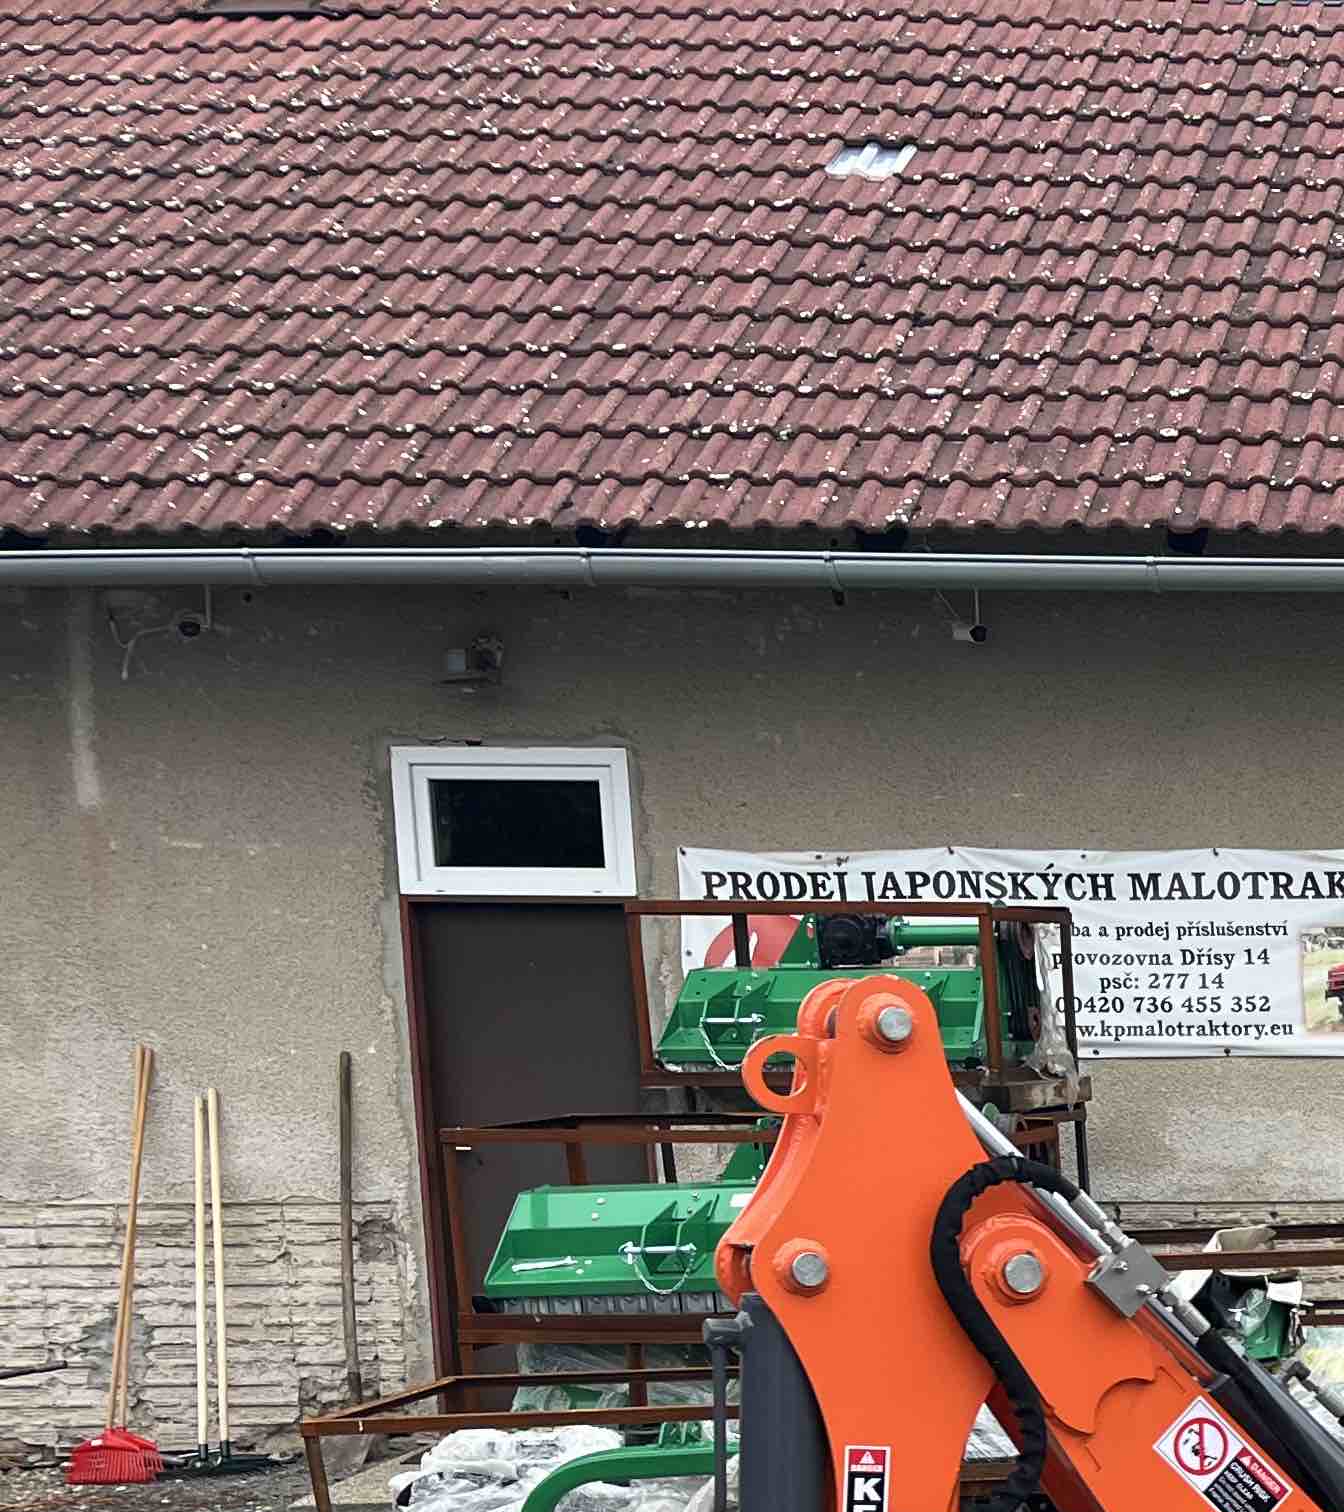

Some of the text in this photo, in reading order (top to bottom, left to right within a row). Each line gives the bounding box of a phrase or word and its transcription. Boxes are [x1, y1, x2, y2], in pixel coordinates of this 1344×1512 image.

[861, 863, 1116, 901] JAPONSKÝCH
[1098, 926, 1109, 937] a
[1116, 922, 1169, 940] prodej
[1176, 920, 1288, 940] příslušenství
[1052, 947, 1270, 970] povozovna Dřísy 14
[1100, 971, 1225, 994] psč: 277 14
[1133, 996, 1174, 1014] 736
[1181, 996, 1223, 1014] 455
[1230, 996, 1271, 1013] 352
